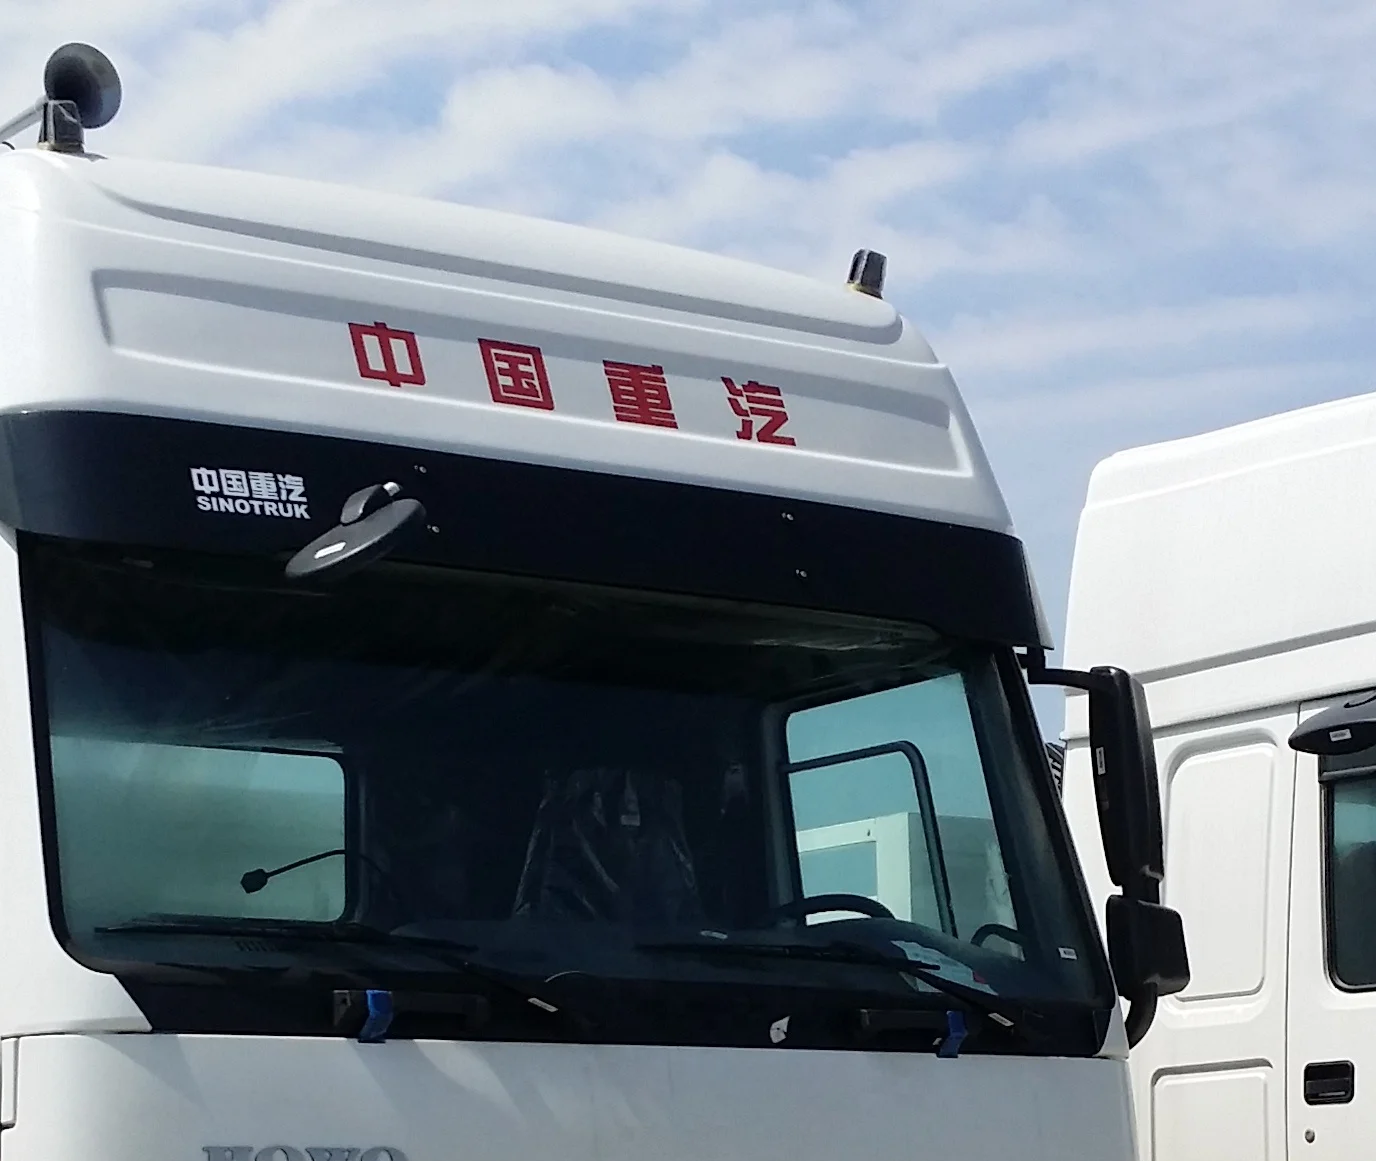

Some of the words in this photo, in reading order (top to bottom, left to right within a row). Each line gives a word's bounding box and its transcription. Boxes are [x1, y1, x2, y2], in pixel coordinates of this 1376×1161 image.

[348, 321, 796, 447] 中国重汽
[190, 467, 307, 502] 中国重汽
[197, 496, 311, 519] SINOTRUK
